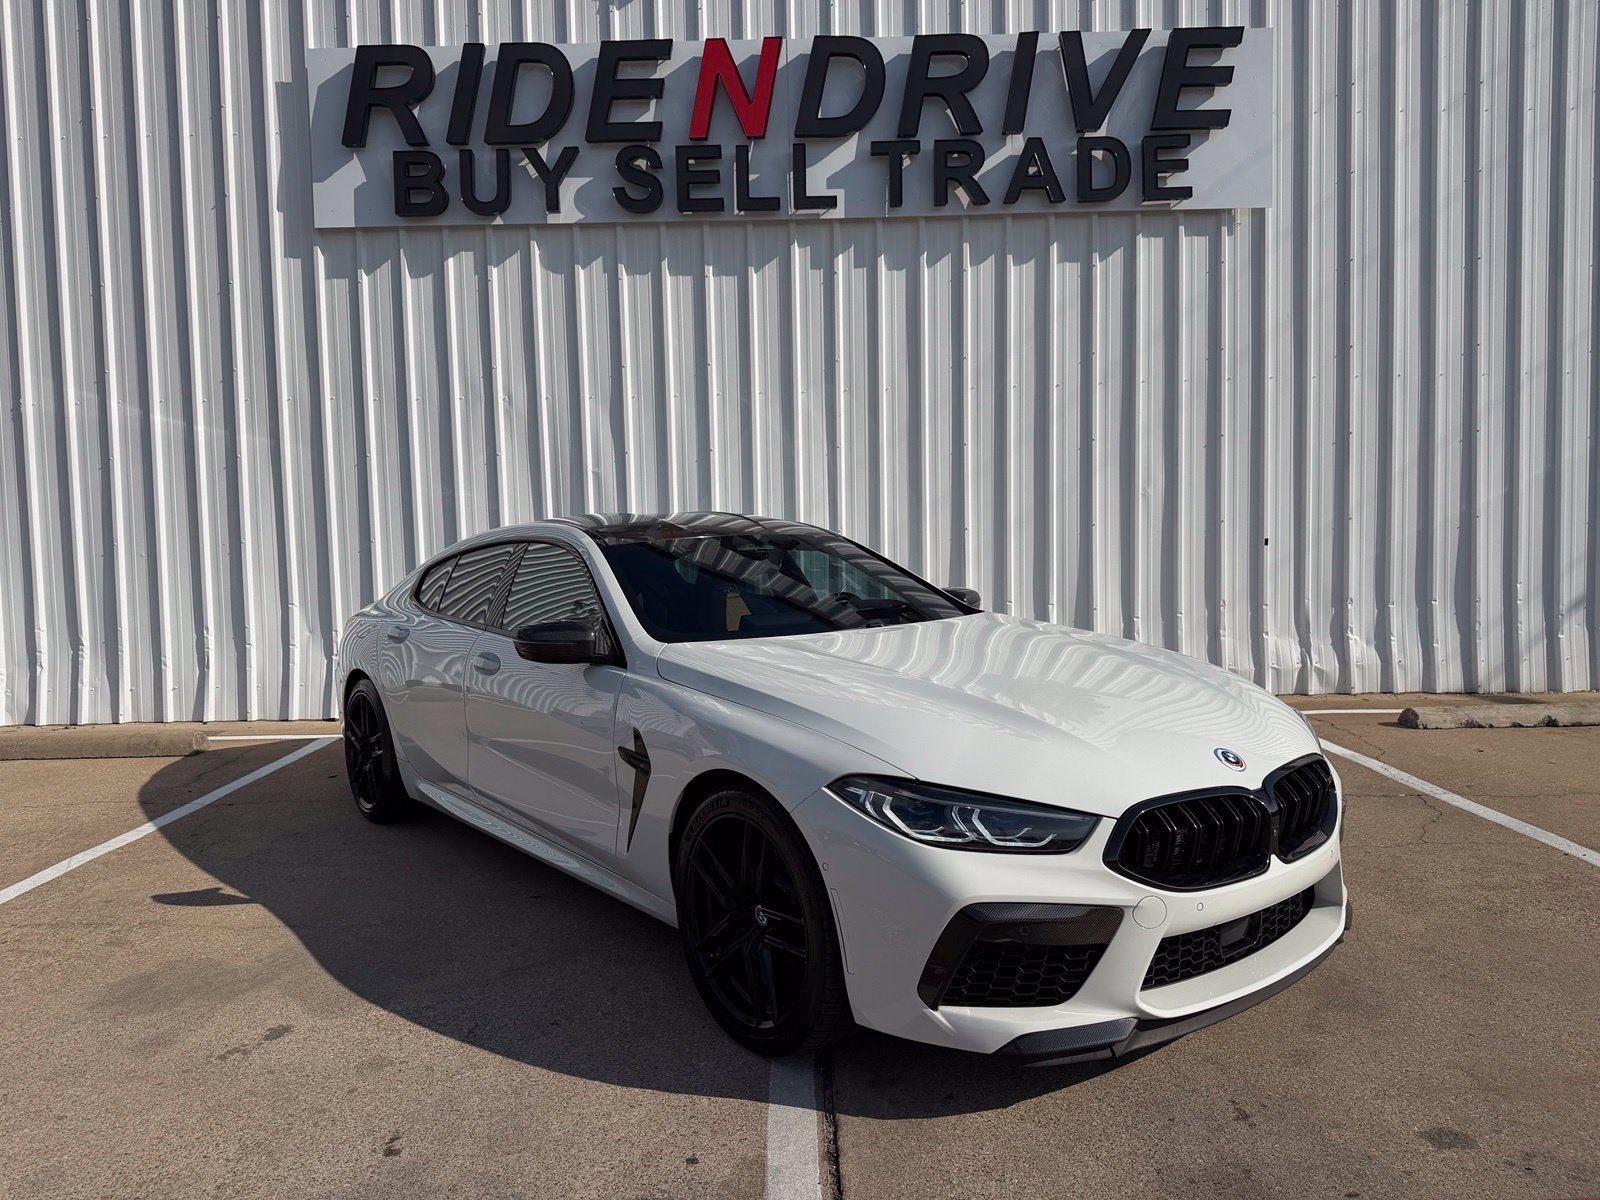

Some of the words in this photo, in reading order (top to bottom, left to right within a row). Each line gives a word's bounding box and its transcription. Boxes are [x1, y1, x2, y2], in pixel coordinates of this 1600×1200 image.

[392, 146, 580, 217] BUY
[612, 142, 838, 214] SELL
[870, 133, 1193, 208] TRADE
